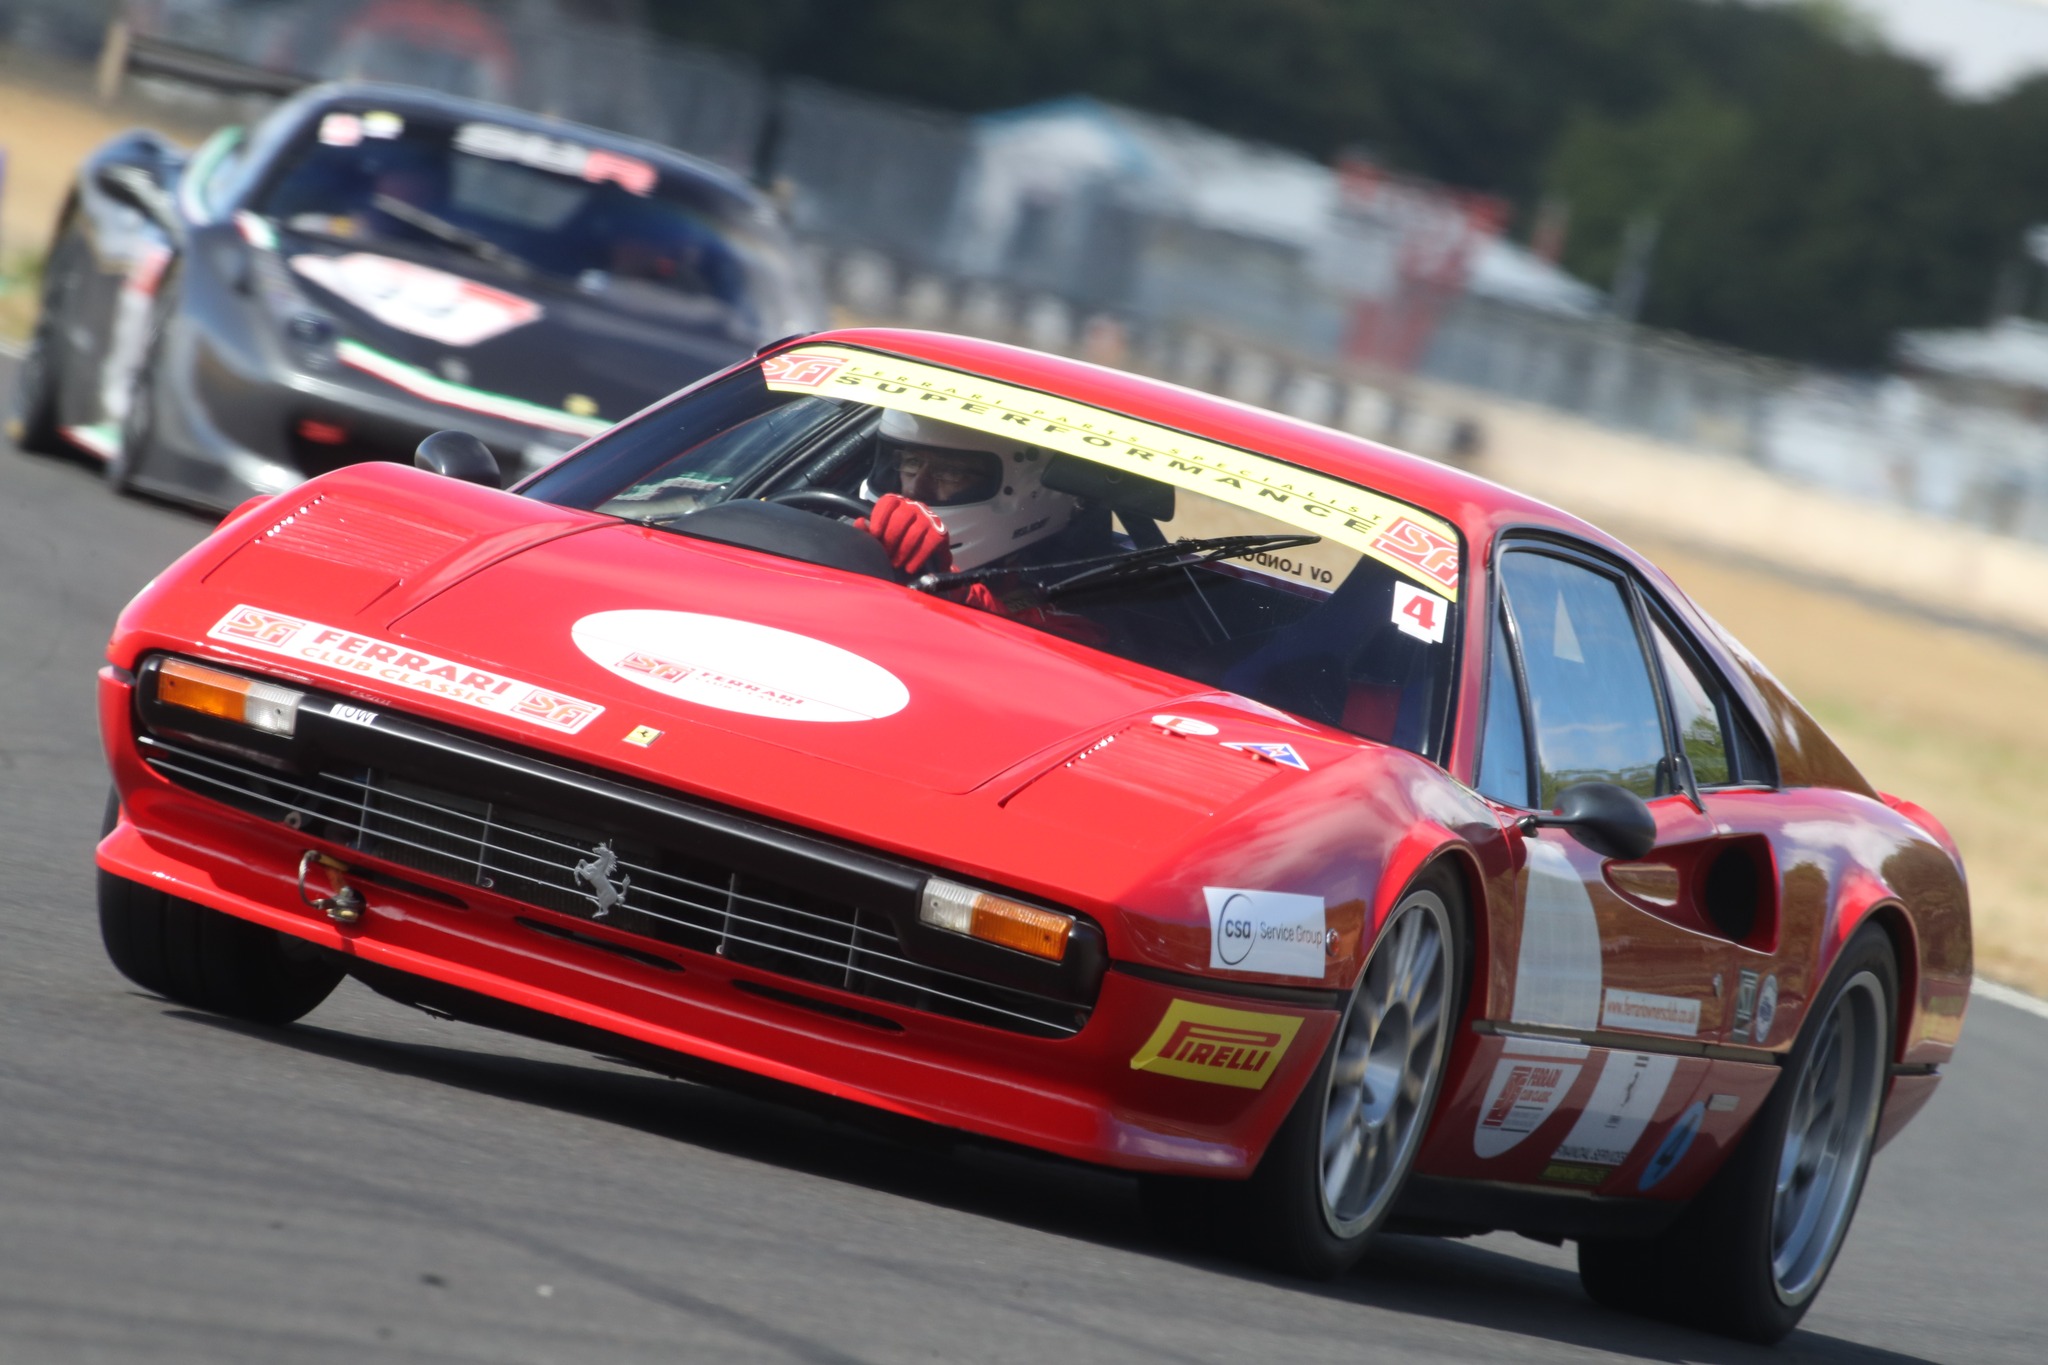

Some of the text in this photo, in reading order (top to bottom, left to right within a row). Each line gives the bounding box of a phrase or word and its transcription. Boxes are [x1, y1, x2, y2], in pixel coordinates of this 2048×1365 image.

[835, 375, 1377, 534] SUPERFORMANCE
[851, 366, 1383, 521] FERRARI PARTS SPECIALIST
[1402, 595, 1436, 630] 4
[300, 646, 496, 706] CLUB CLASSIC
[312, 629, 513, 695] FERRARI
[1259, 923, 1323, 948] Service Group
[1157, 1020, 1282, 1073] PIRELLI
